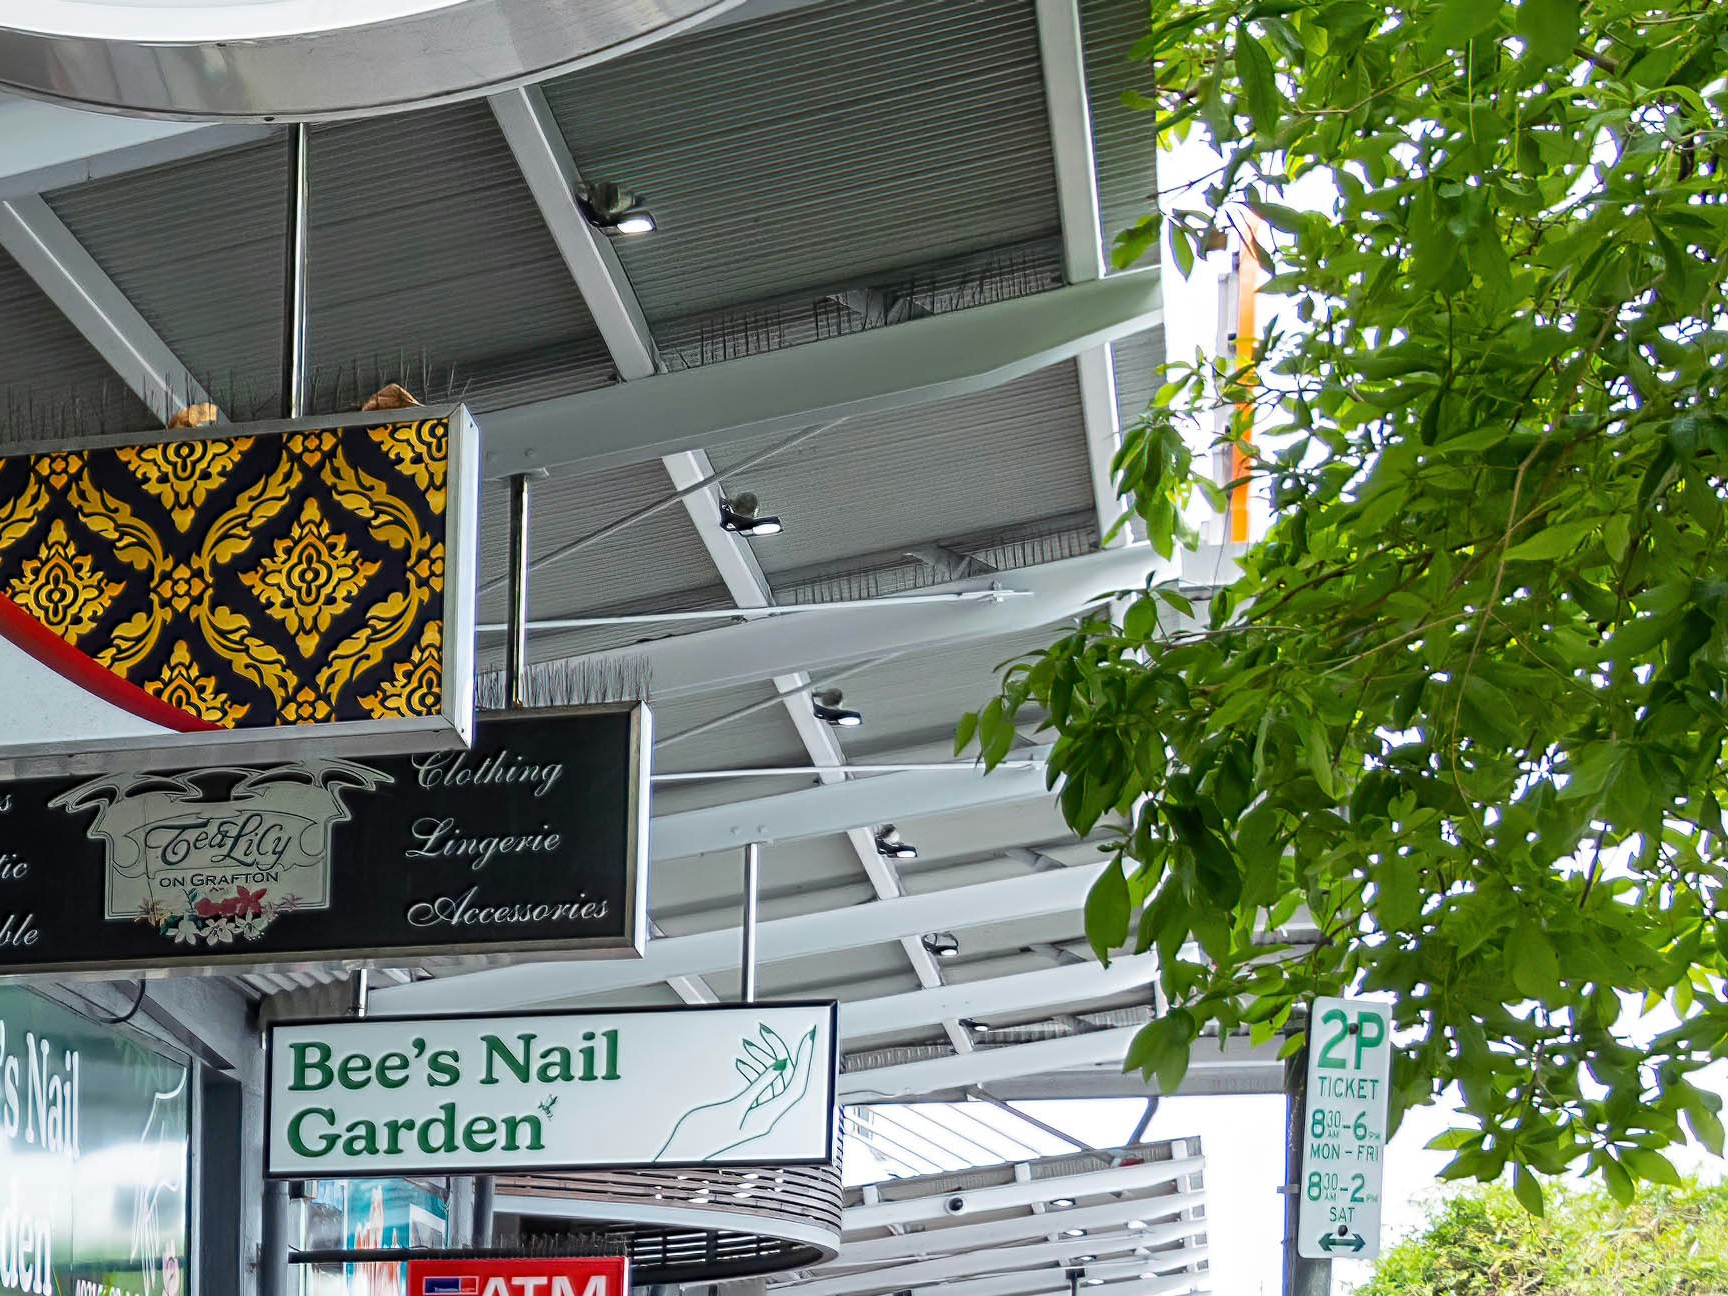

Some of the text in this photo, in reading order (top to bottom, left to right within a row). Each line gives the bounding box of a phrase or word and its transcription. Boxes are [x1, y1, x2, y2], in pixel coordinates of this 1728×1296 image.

[411, 750, 563, 797] Clothing
[405, 817, 562, 871] Lingerie
[159, 874, 186, 888] ON
[407, 885, 609, 927] Accessories
[288, 1029, 621, 1092] Bee's Nail
[1317, 1008, 1385, 1070] 2P
[25, 1033, 82, 1160] Nail
[1318, 1075, 1379, 1100] TICKET
[287, 1102, 546, 1158] Garden
[1310, 1143, 1379, 1162] MON FRI
[1329, 1207, 1355, 1223] SAT
